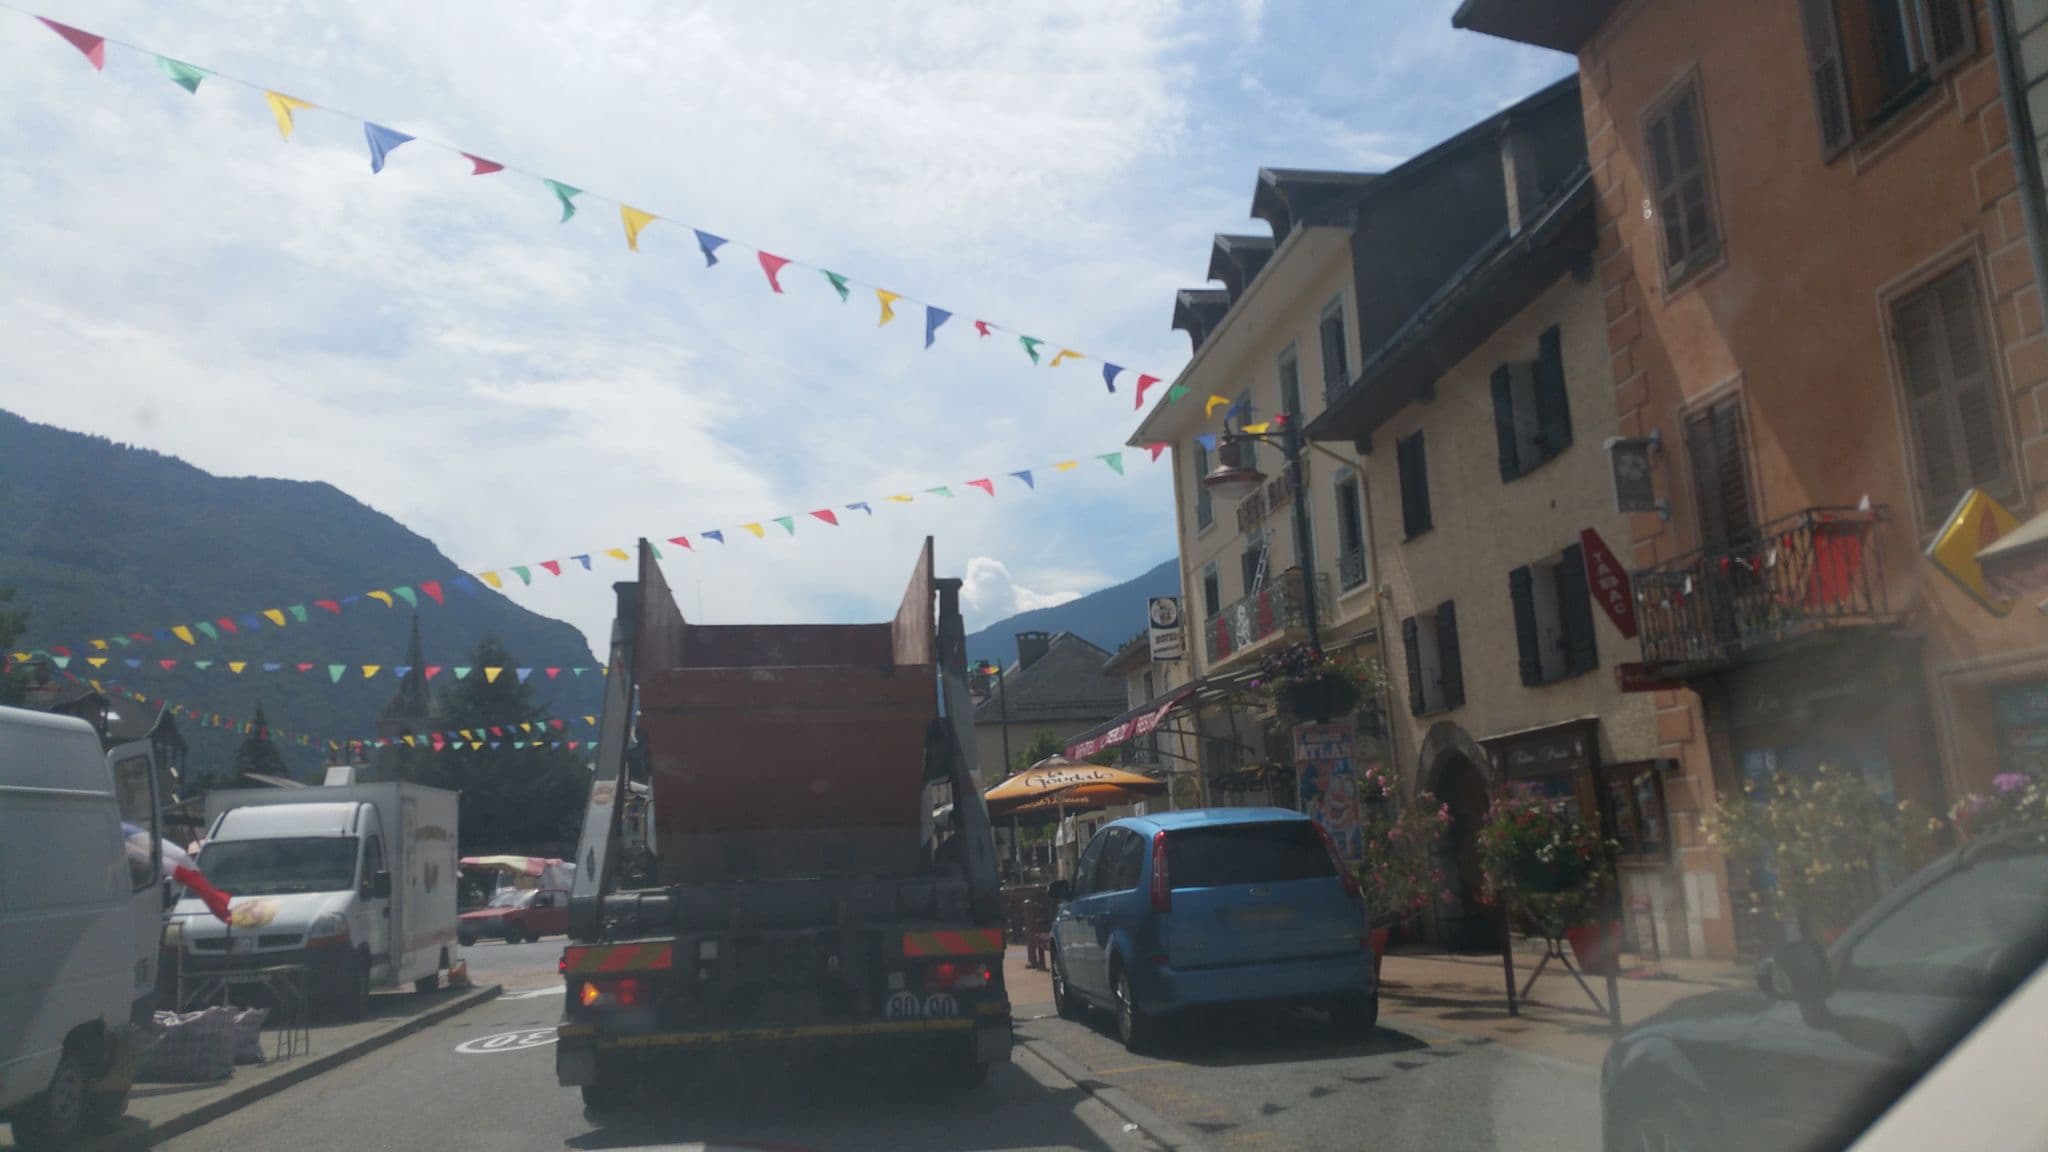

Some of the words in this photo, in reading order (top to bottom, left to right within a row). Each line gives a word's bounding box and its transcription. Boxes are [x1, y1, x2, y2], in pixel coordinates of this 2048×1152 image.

[1592, 551, 1625, 614] TABAC
[1298, 742, 1352, 760] ATLAS
[1025, 770, 1113, 788] Goudale
[482, 1030, 553, 1048] 30
